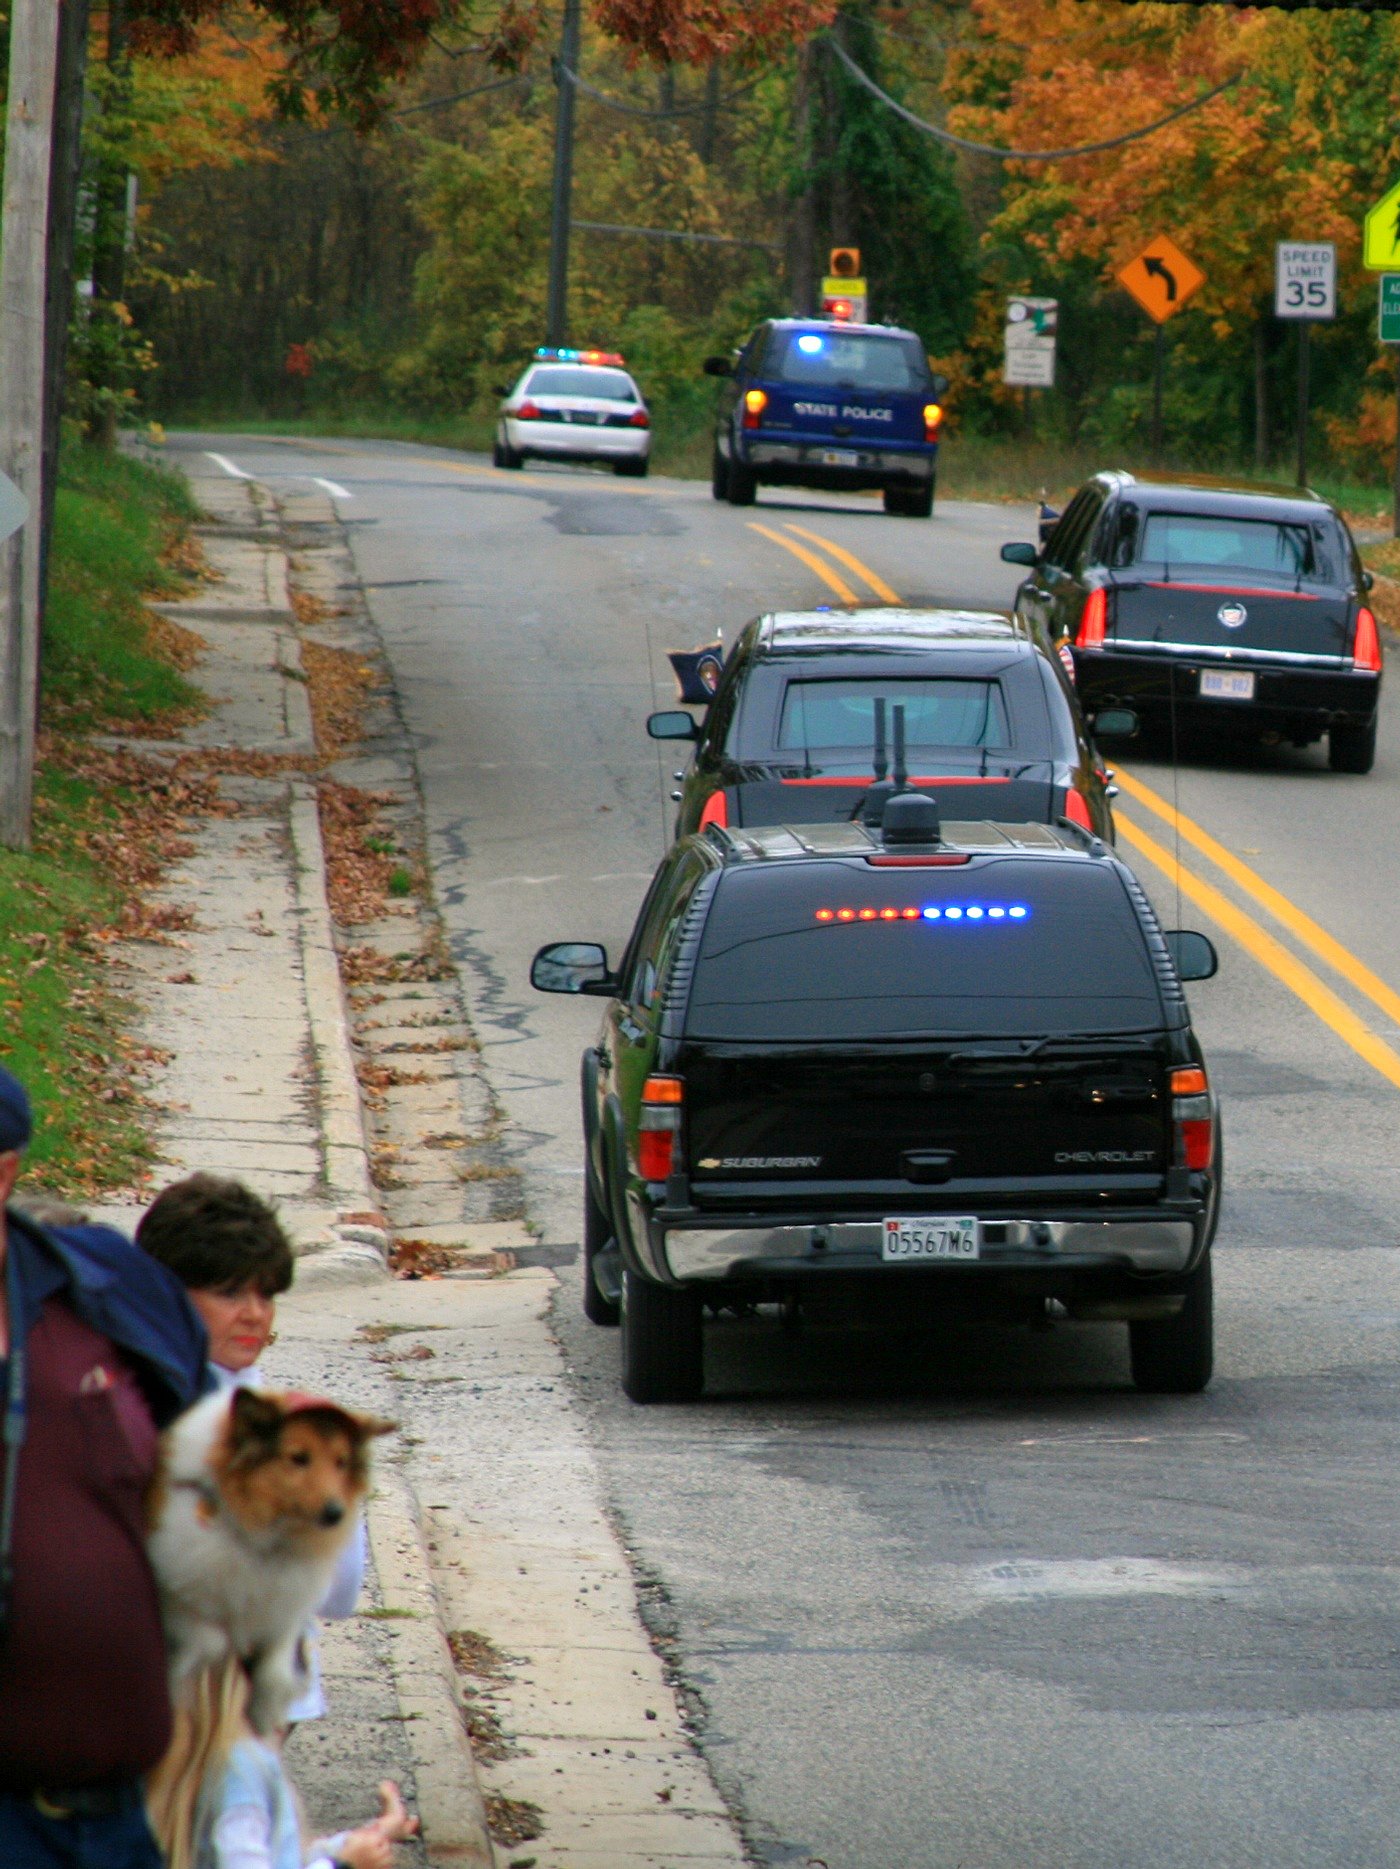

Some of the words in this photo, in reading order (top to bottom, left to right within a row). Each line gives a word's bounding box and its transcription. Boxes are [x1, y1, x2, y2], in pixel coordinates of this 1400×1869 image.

[1283, 250, 1332, 263] SPEED
[1286, 265, 1324, 277] LIMIT
[1285, 280, 1328, 307] 35
[793, 402, 838, 417] STATE
[842, 406, 893, 421] POLICE
[1054, 1150, 1156, 1162] CHEVROLET
[721, 1157, 820, 1169] SUBURBAN
[888, 1229, 974, 1254] 05567M6
